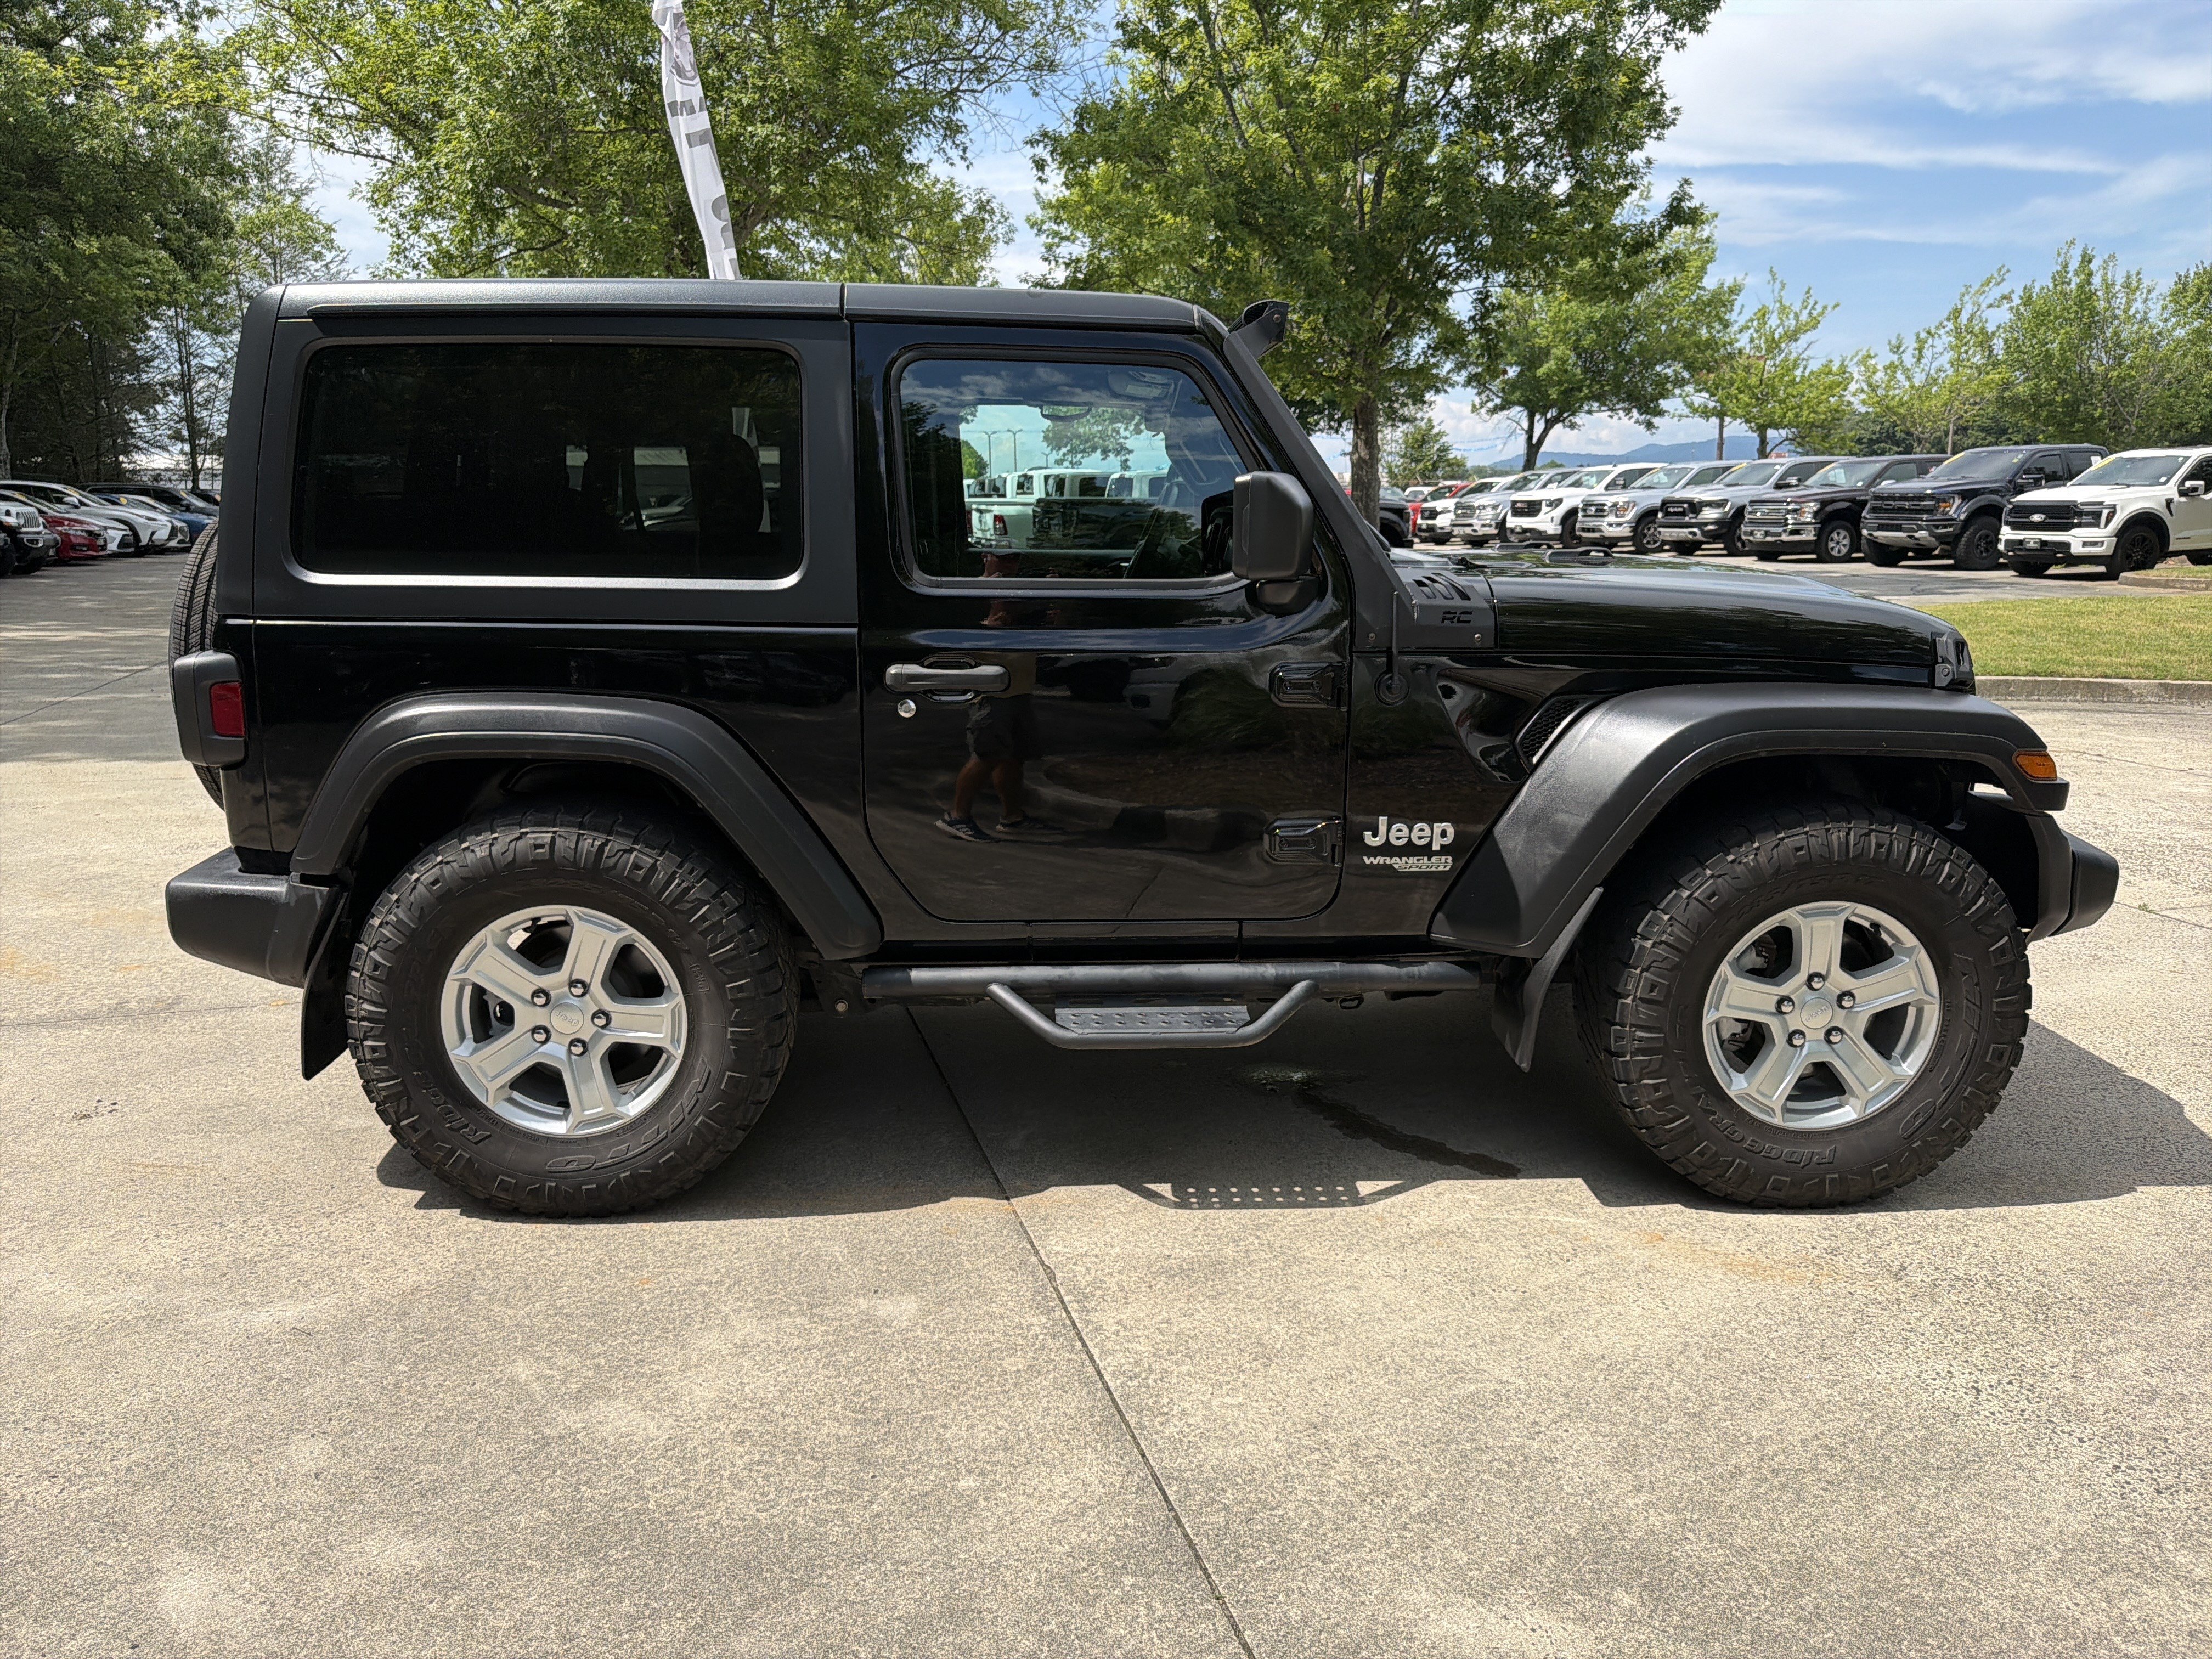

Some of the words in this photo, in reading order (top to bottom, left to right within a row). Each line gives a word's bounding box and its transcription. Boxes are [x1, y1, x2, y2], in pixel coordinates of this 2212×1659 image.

[1441, 611, 1473, 624] RC
[1363, 816, 1455, 851] Jeep
[1362, 856, 1453, 865] WRANGLER
[546, 1054, 712, 1173] NITTO
[1743, 1137, 1837, 1169] RIDGE
